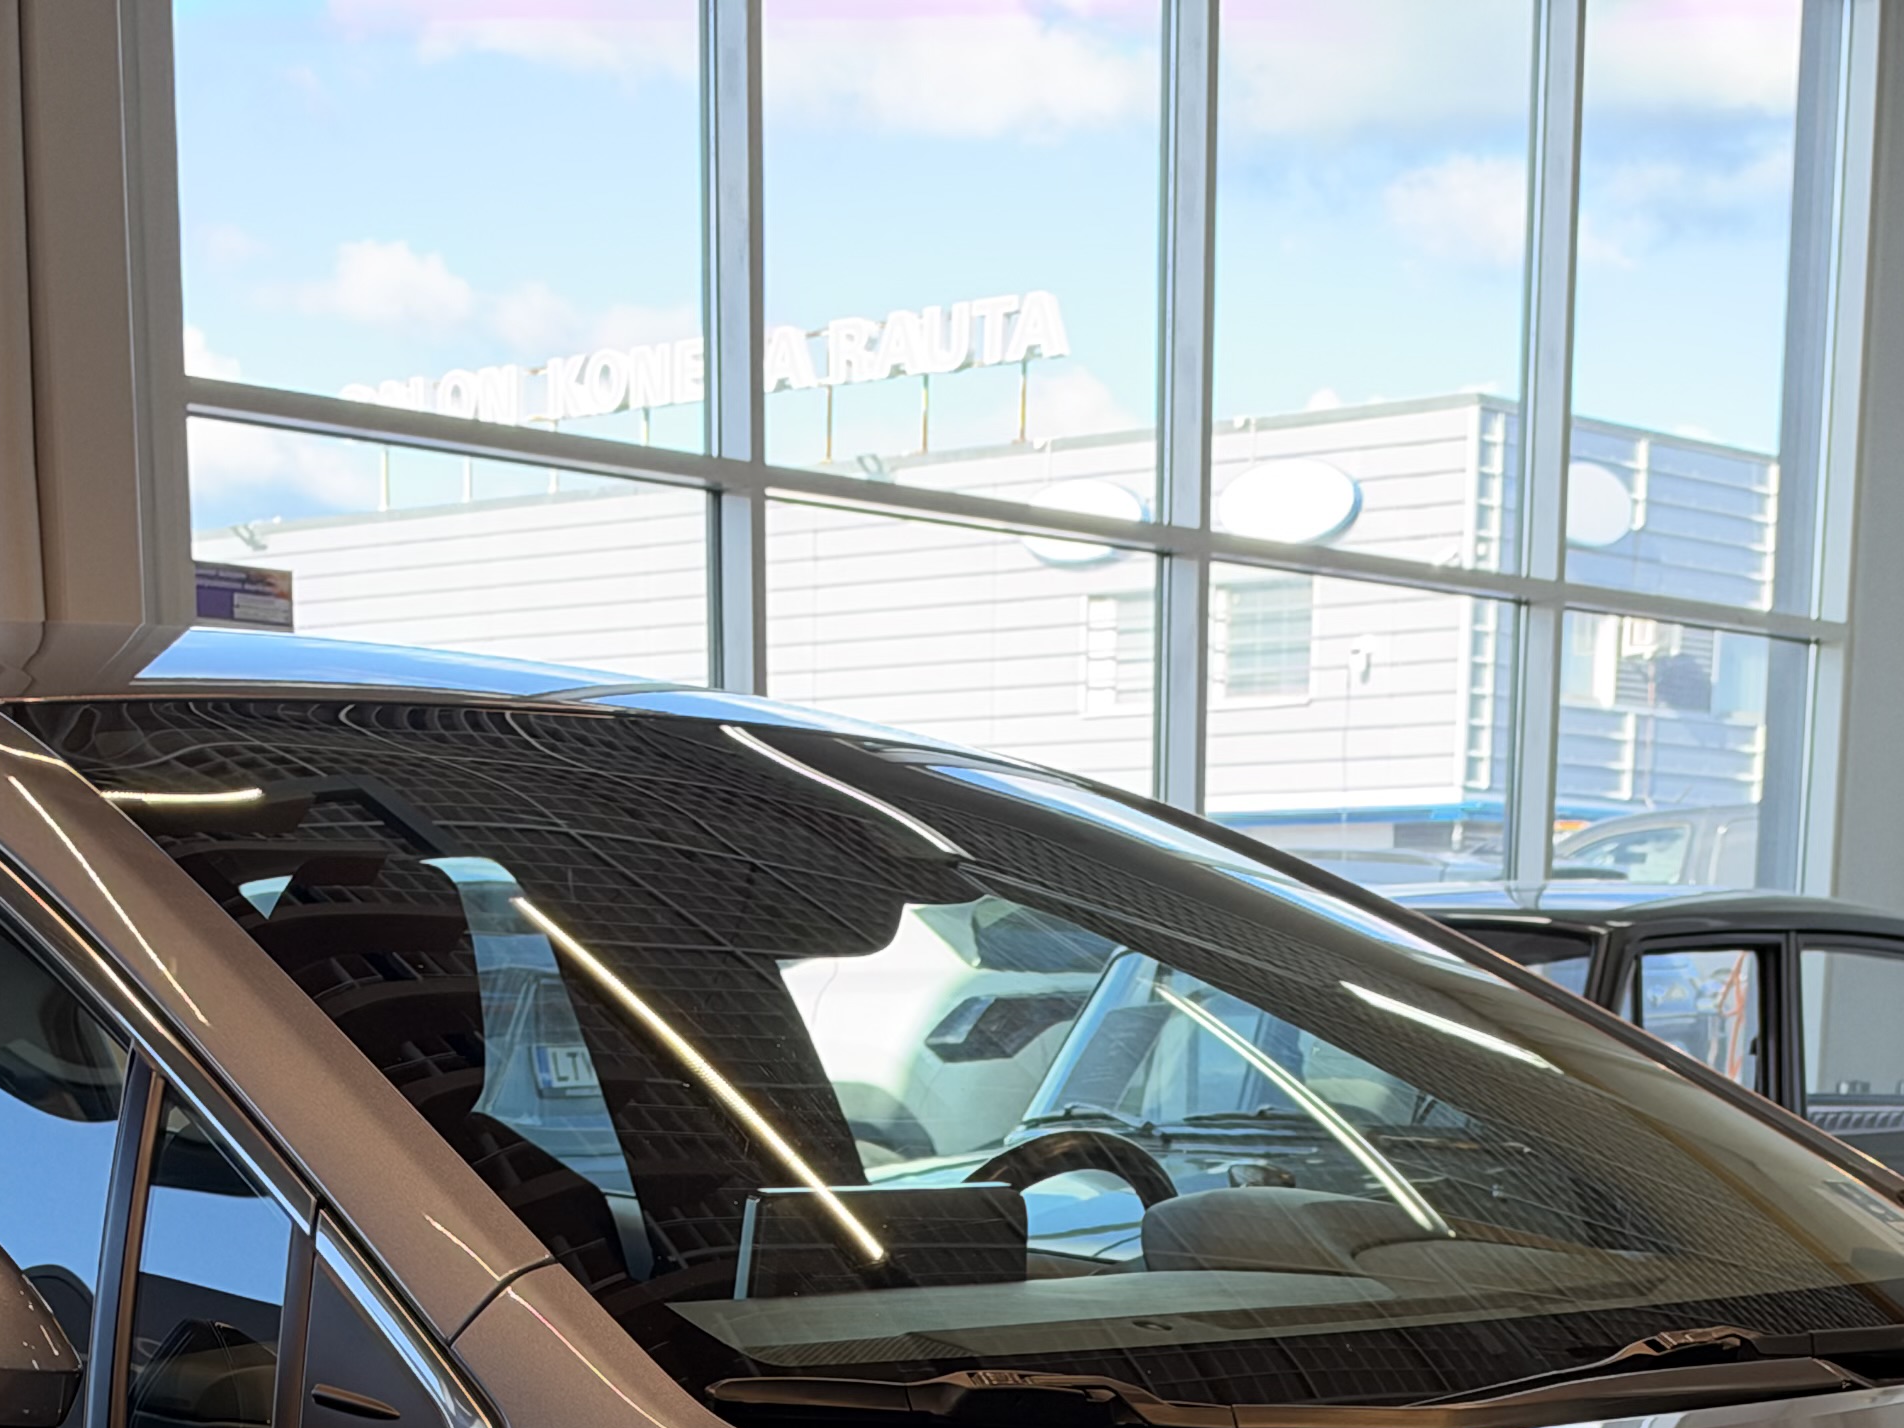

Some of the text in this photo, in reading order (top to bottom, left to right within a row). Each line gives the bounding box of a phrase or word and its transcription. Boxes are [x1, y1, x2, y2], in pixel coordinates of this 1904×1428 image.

[547, 338, 704, 420] KONE
[765, 325, 817, 394] A
[828, 290, 1071, 388] RAUTA
